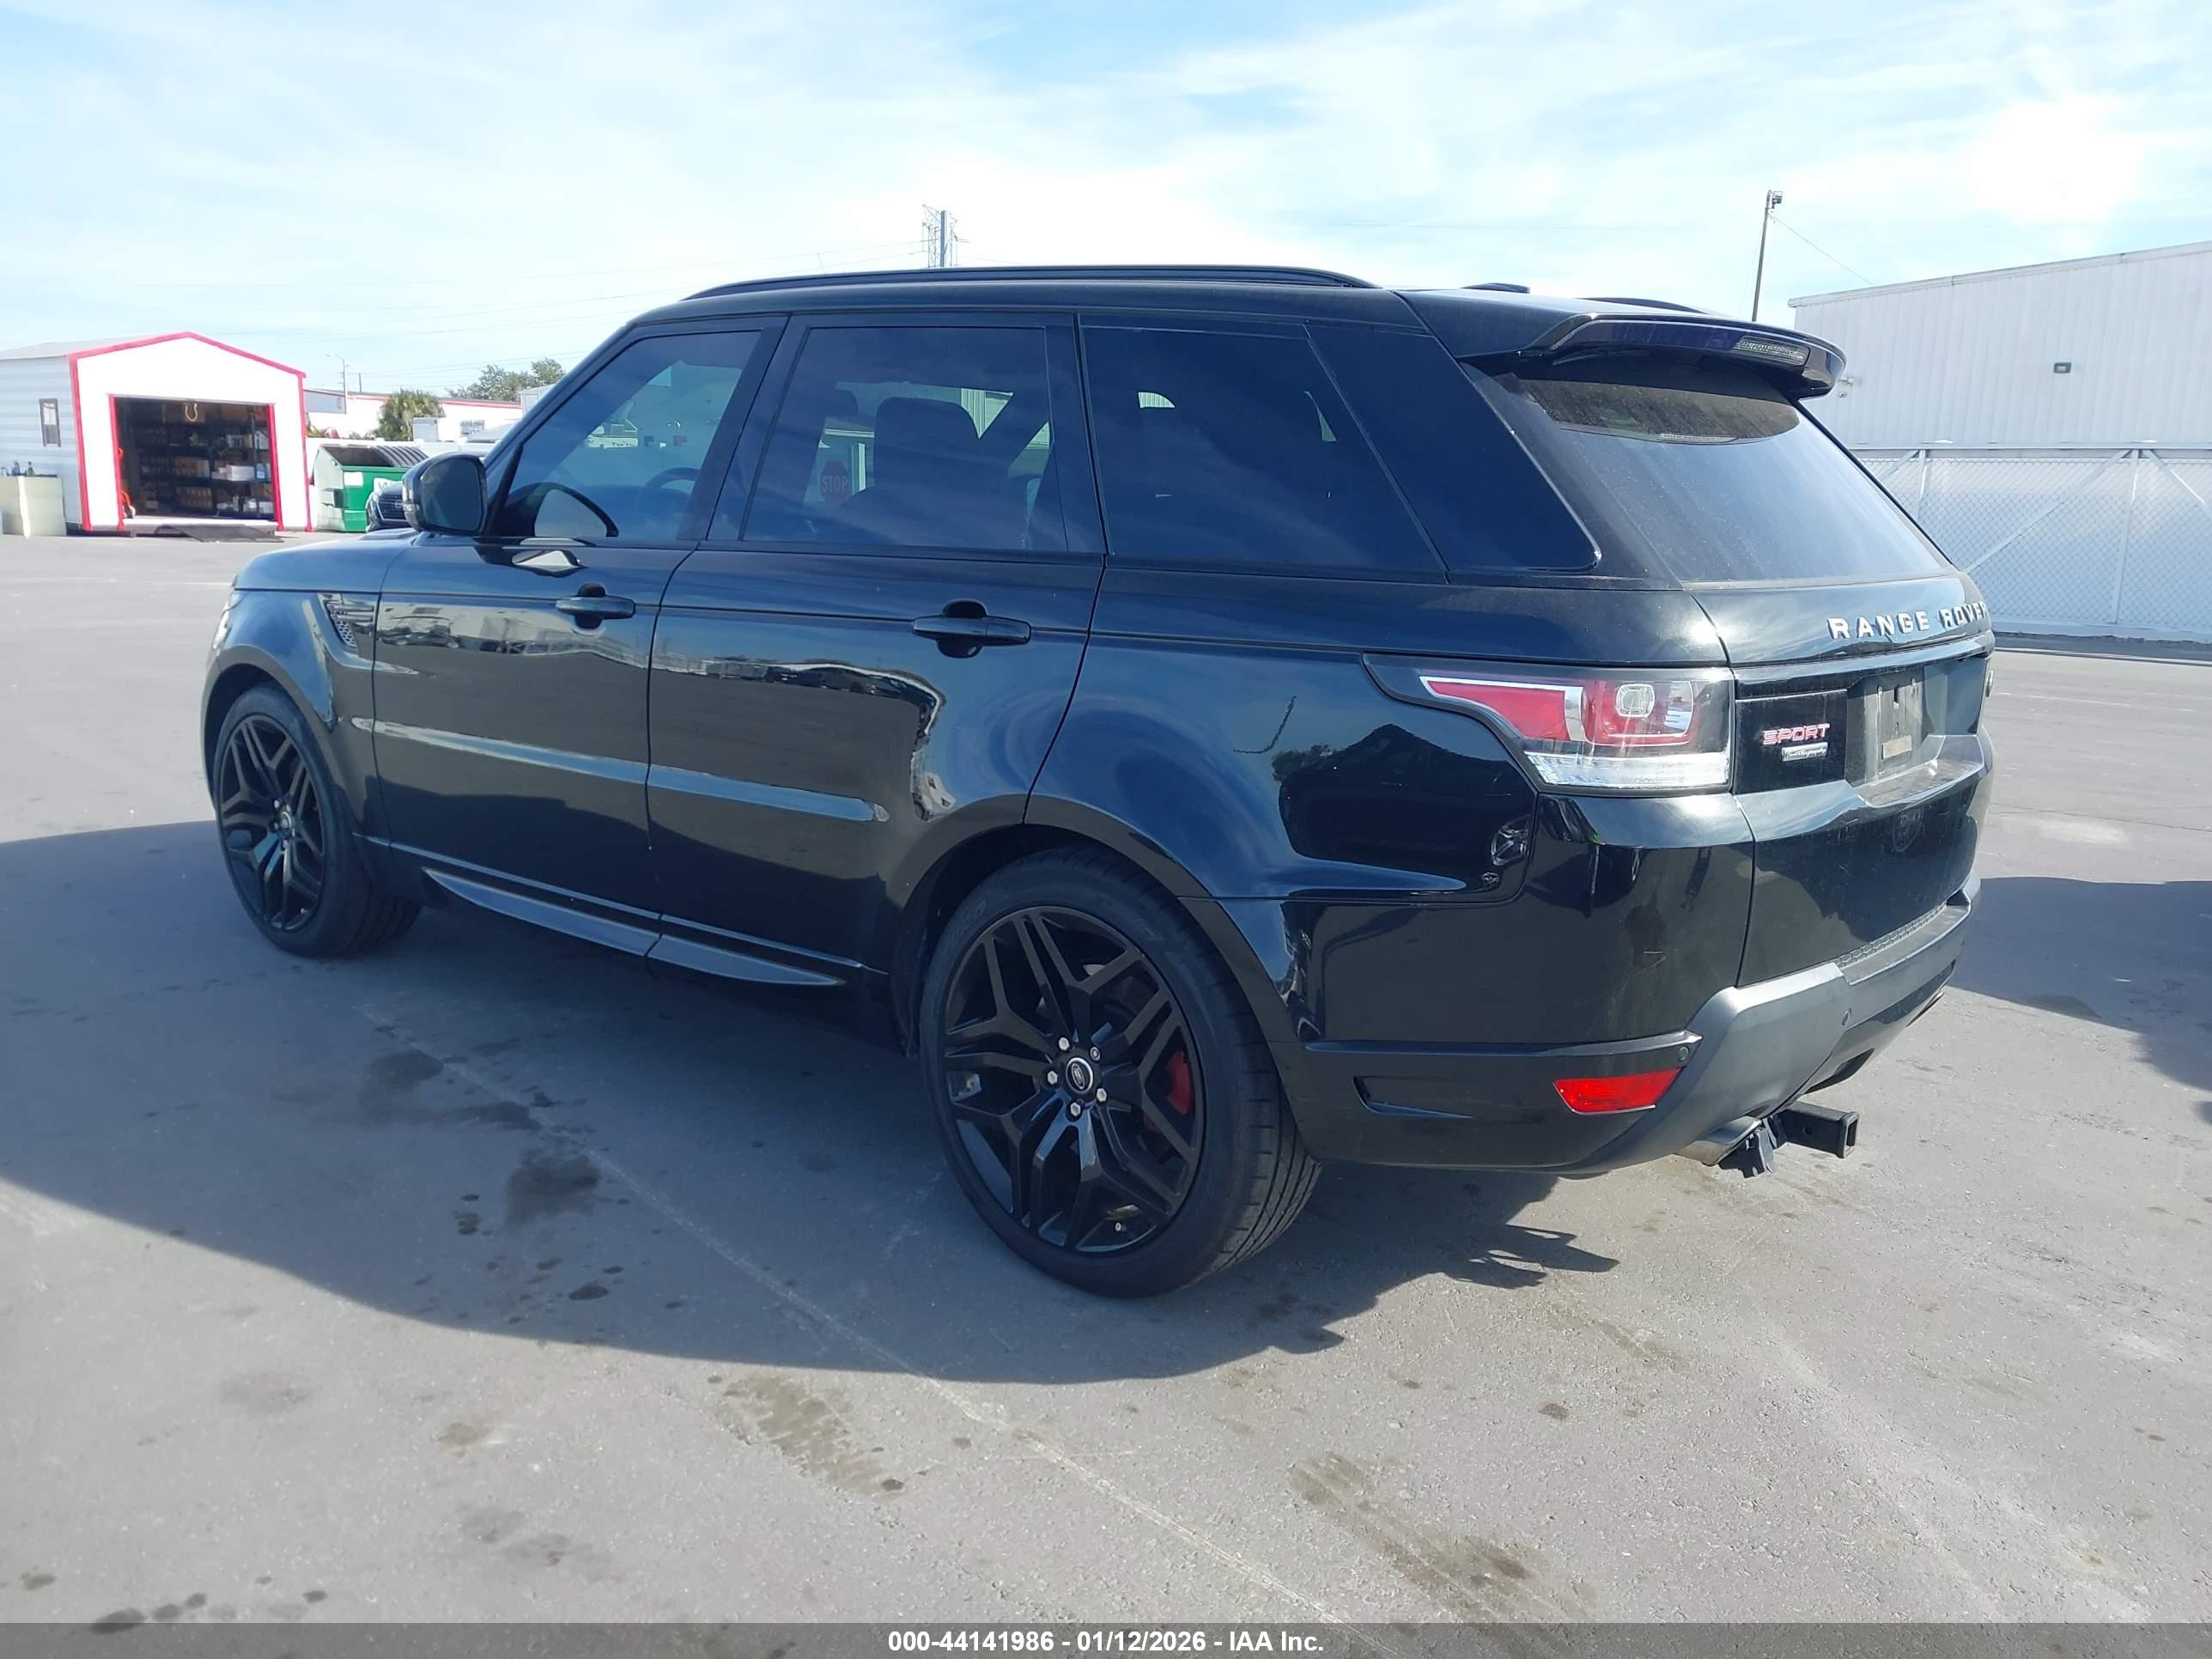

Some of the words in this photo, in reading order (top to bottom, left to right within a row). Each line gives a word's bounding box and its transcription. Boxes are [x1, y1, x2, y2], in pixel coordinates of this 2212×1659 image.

[822, 475, 848, 493] STOP
[1827, 611, 1930, 640] RANGE
[1938, 601, 1987, 629] ROVER
[1761, 722, 1831, 745] SPORT
